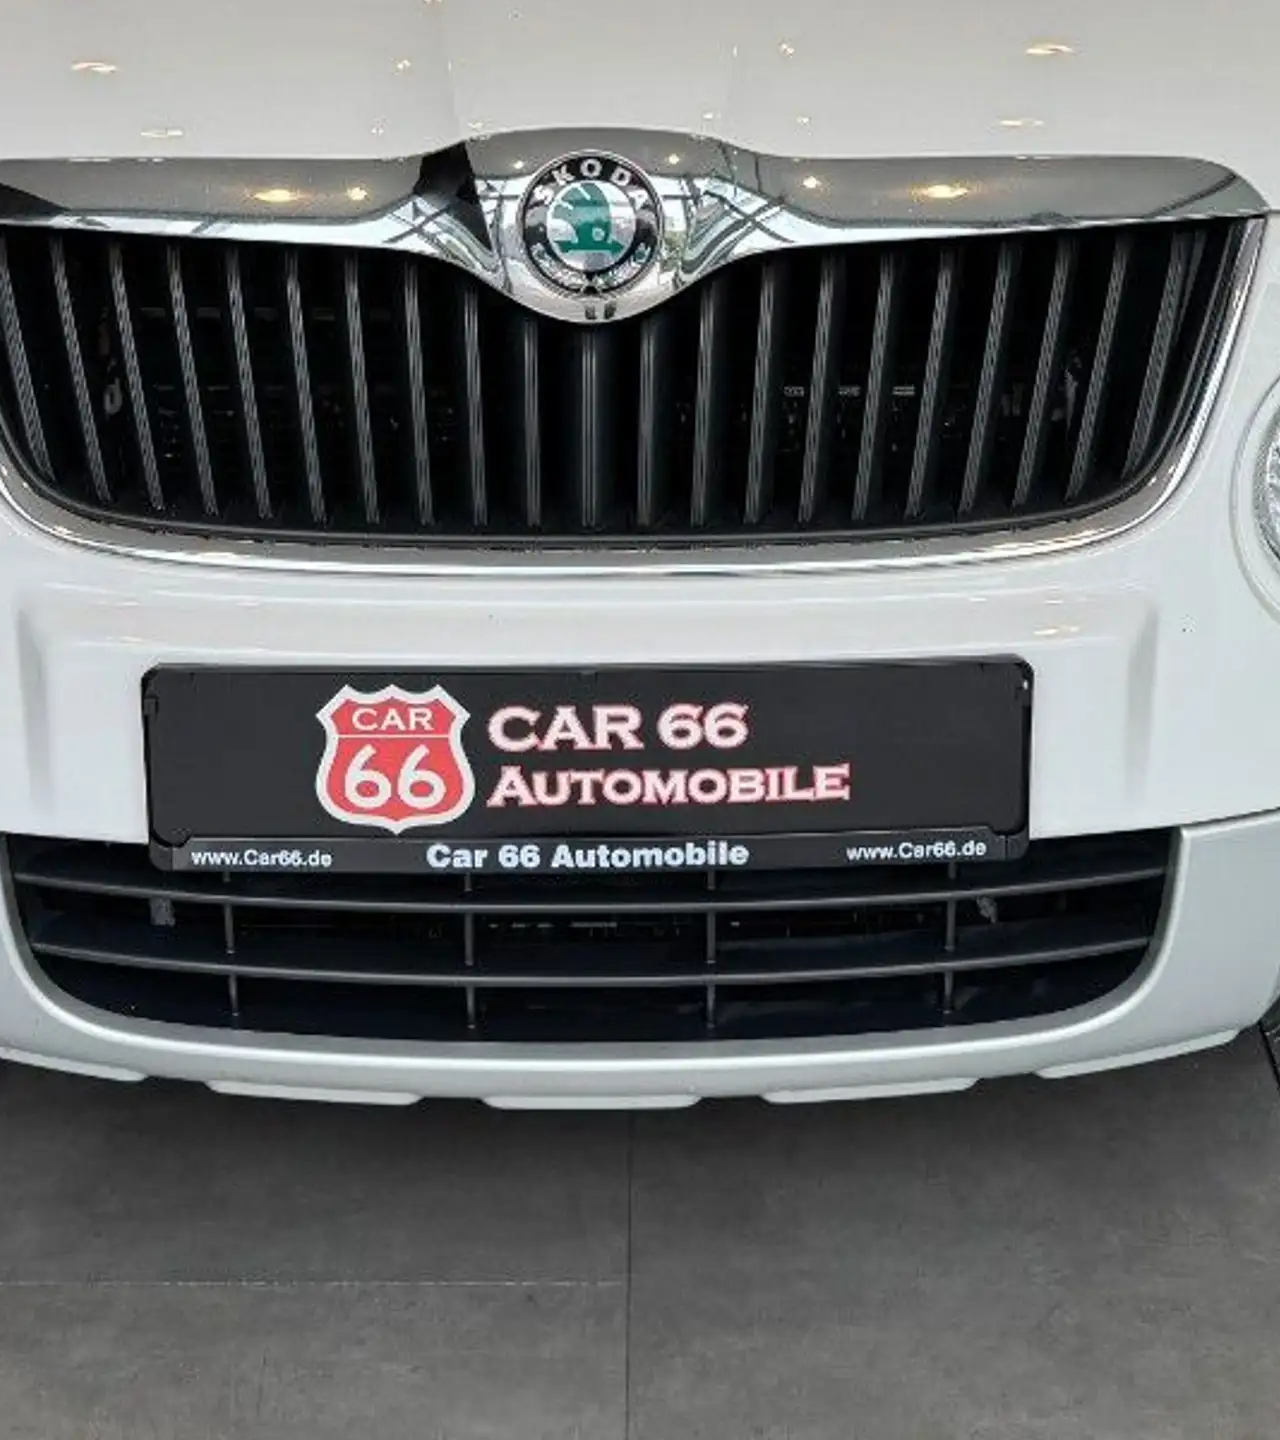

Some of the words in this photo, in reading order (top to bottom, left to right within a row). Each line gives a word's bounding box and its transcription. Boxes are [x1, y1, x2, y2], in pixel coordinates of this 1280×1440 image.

[351, 707, 435, 732] CAR
[487, 704, 644, 753] CAR
[657, 702, 750, 750] 66
[344, 744, 447, 810] 66
[191, 848, 332, 867] www.Car66.de
[426, 843, 488, 869] Car
[498, 844, 541, 868] 66
[551, 839, 750, 871] Automobile
[846, 841, 987, 862] www.Car66.de
